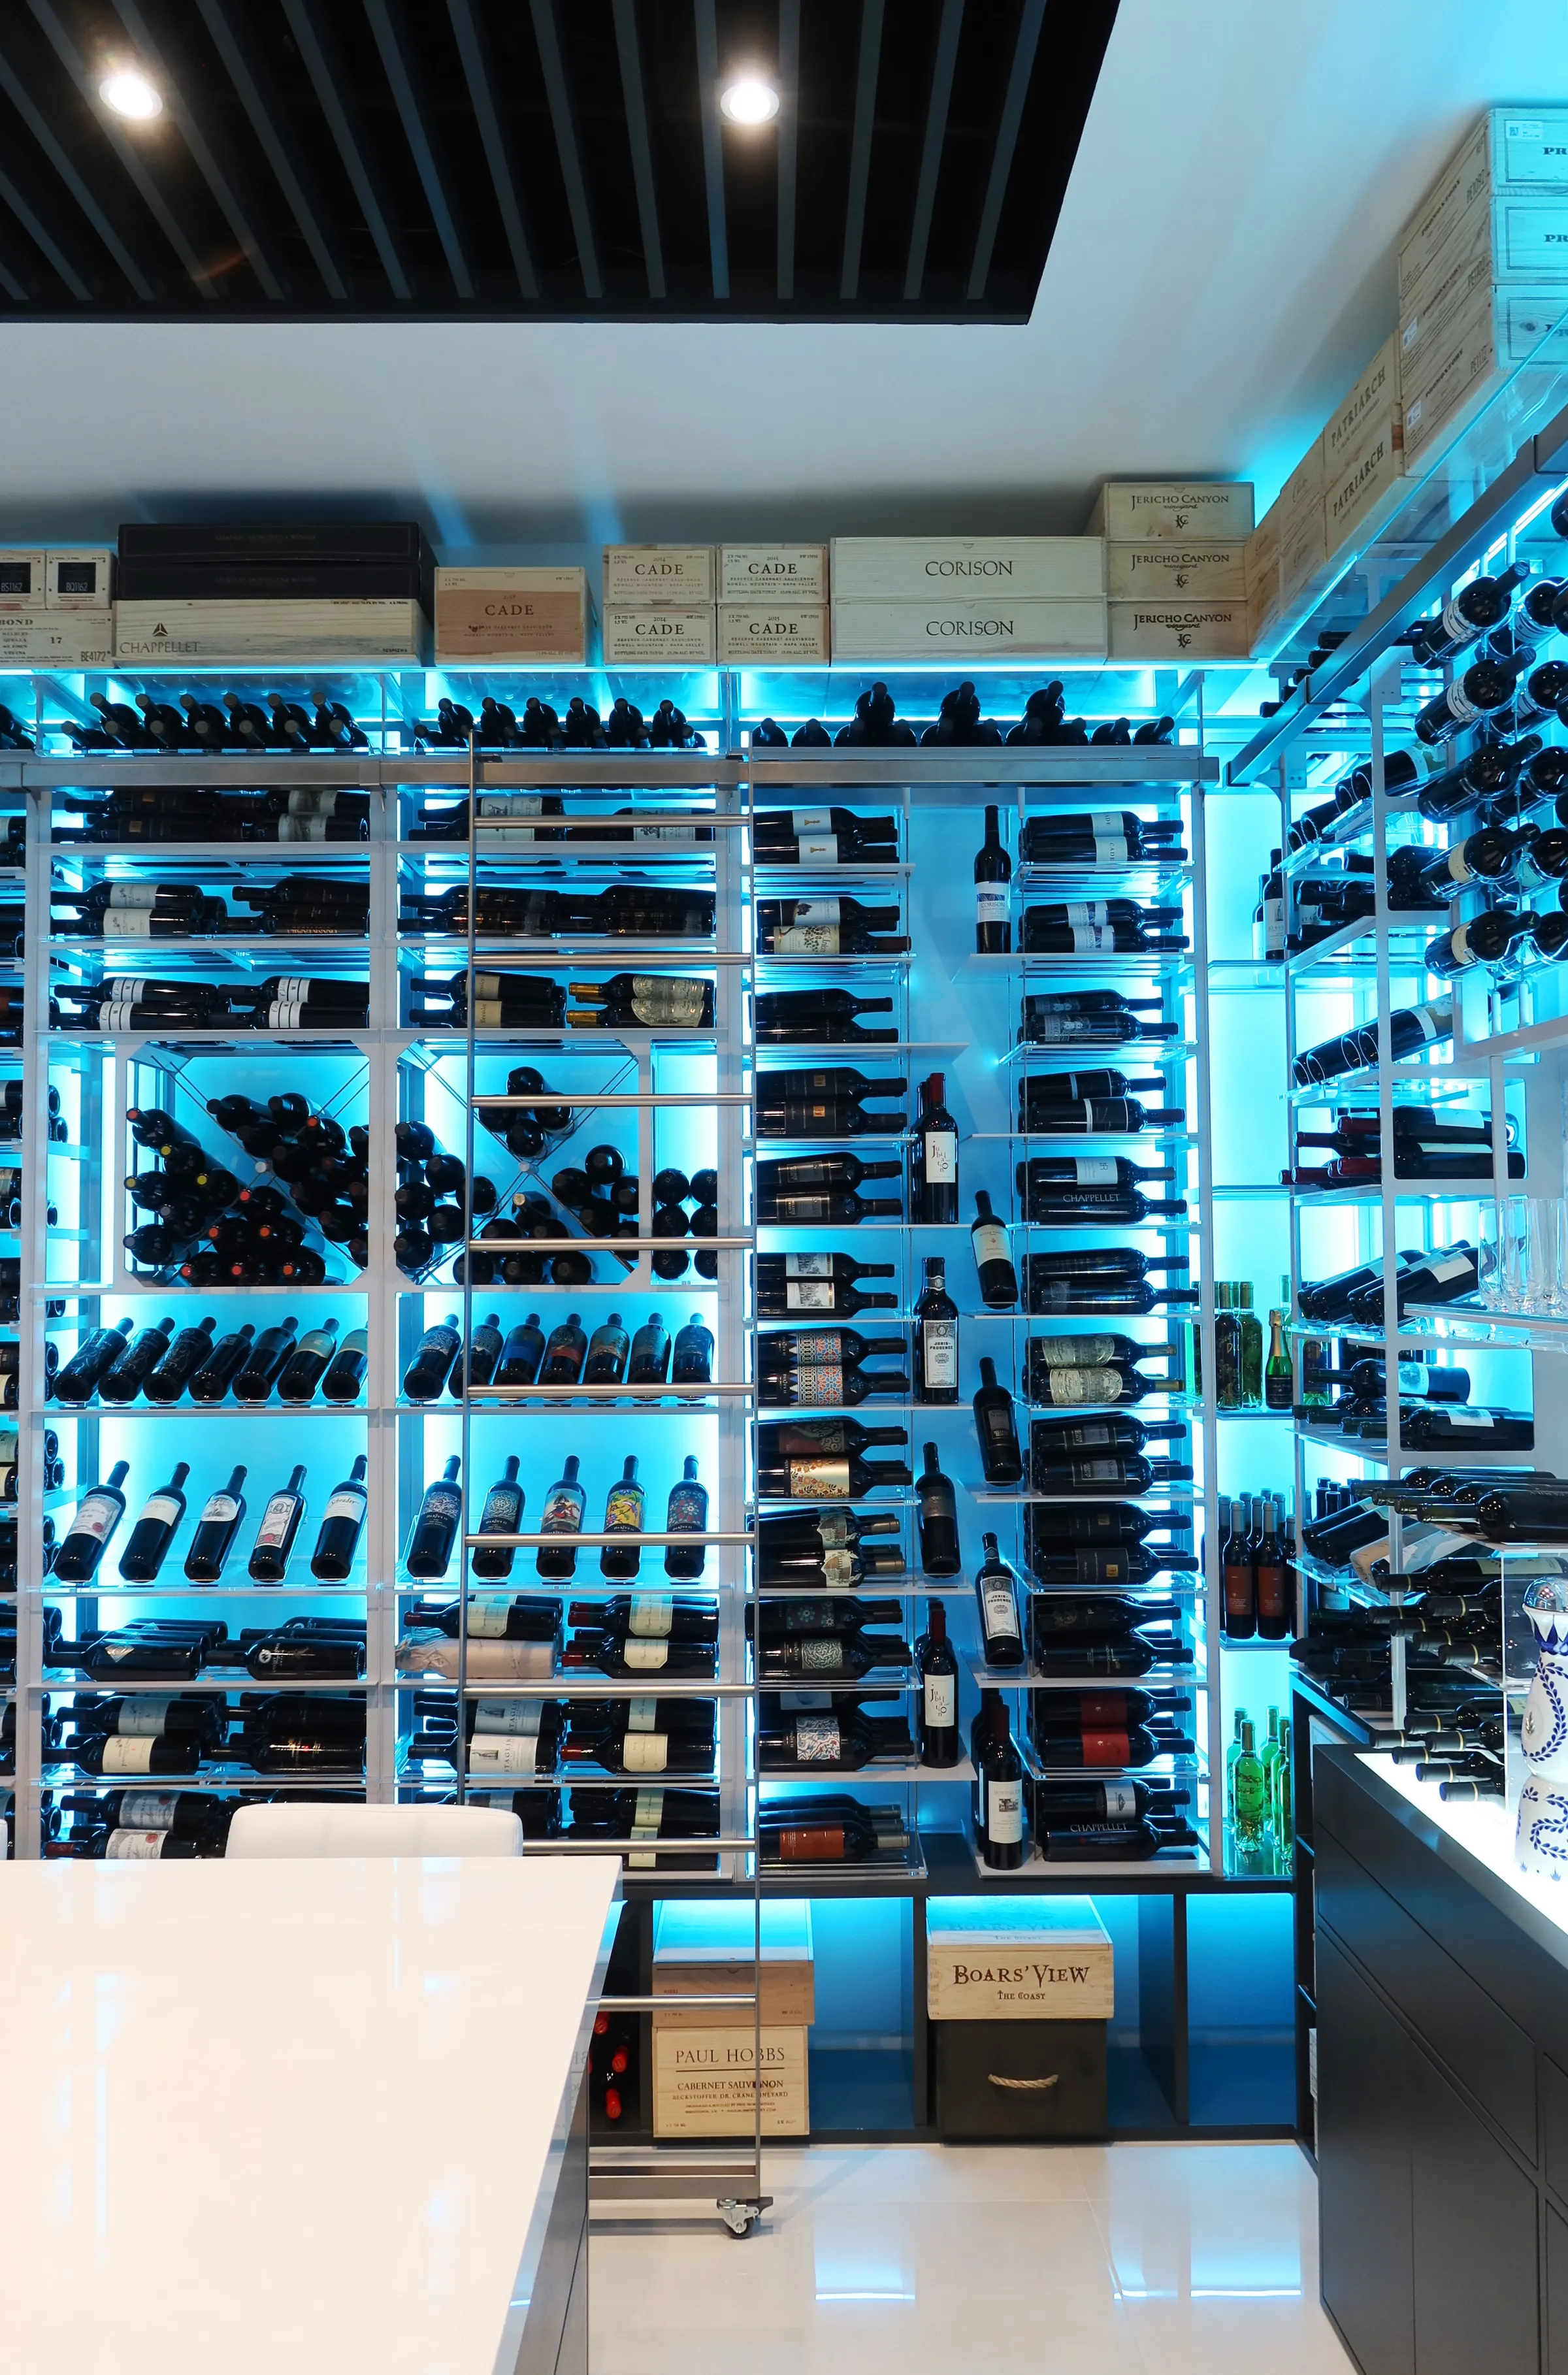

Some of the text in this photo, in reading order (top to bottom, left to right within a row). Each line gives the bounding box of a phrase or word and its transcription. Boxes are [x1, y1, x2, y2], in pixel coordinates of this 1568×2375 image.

[1331, 365, 1386, 448] PATRIARCH
[1333, 440, 1384, 517] PATRIARCH
[1132, 495, 1230, 512] JERICHO CANYON
[1132, 554, 1230, 571] JERICHO CANYON
[635, 564, 683, 574] CADE
[749, 563, 797, 574] CADE
[925, 561, 1012, 576] CORISON
[485, 604, 534, 615] CADE
[1134, 614, 1232, 631] JERICHO CANYON
[635, 624, 684, 634] CADE
[749, 623, 798, 634] CADE
[926, 621, 1013, 636] CORISON
[120, 642, 201, 653] CHAPPELLET
[81, 651, 106, 662] BE4172
[1063, 1194, 1120, 1202] CHAPPELLET
[329, 1498, 359, 1508] Schrader
[1070, 1823, 1127, 1832] CHAPPELLET
[953, 1965, 1090, 1988] BOARS' VIEW
[997, 1990, 1015, 2000] THE
[676, 2049, 719, 2063] PAUL
[678, 2080, 783, 2090] CABERNET SAUVINON
